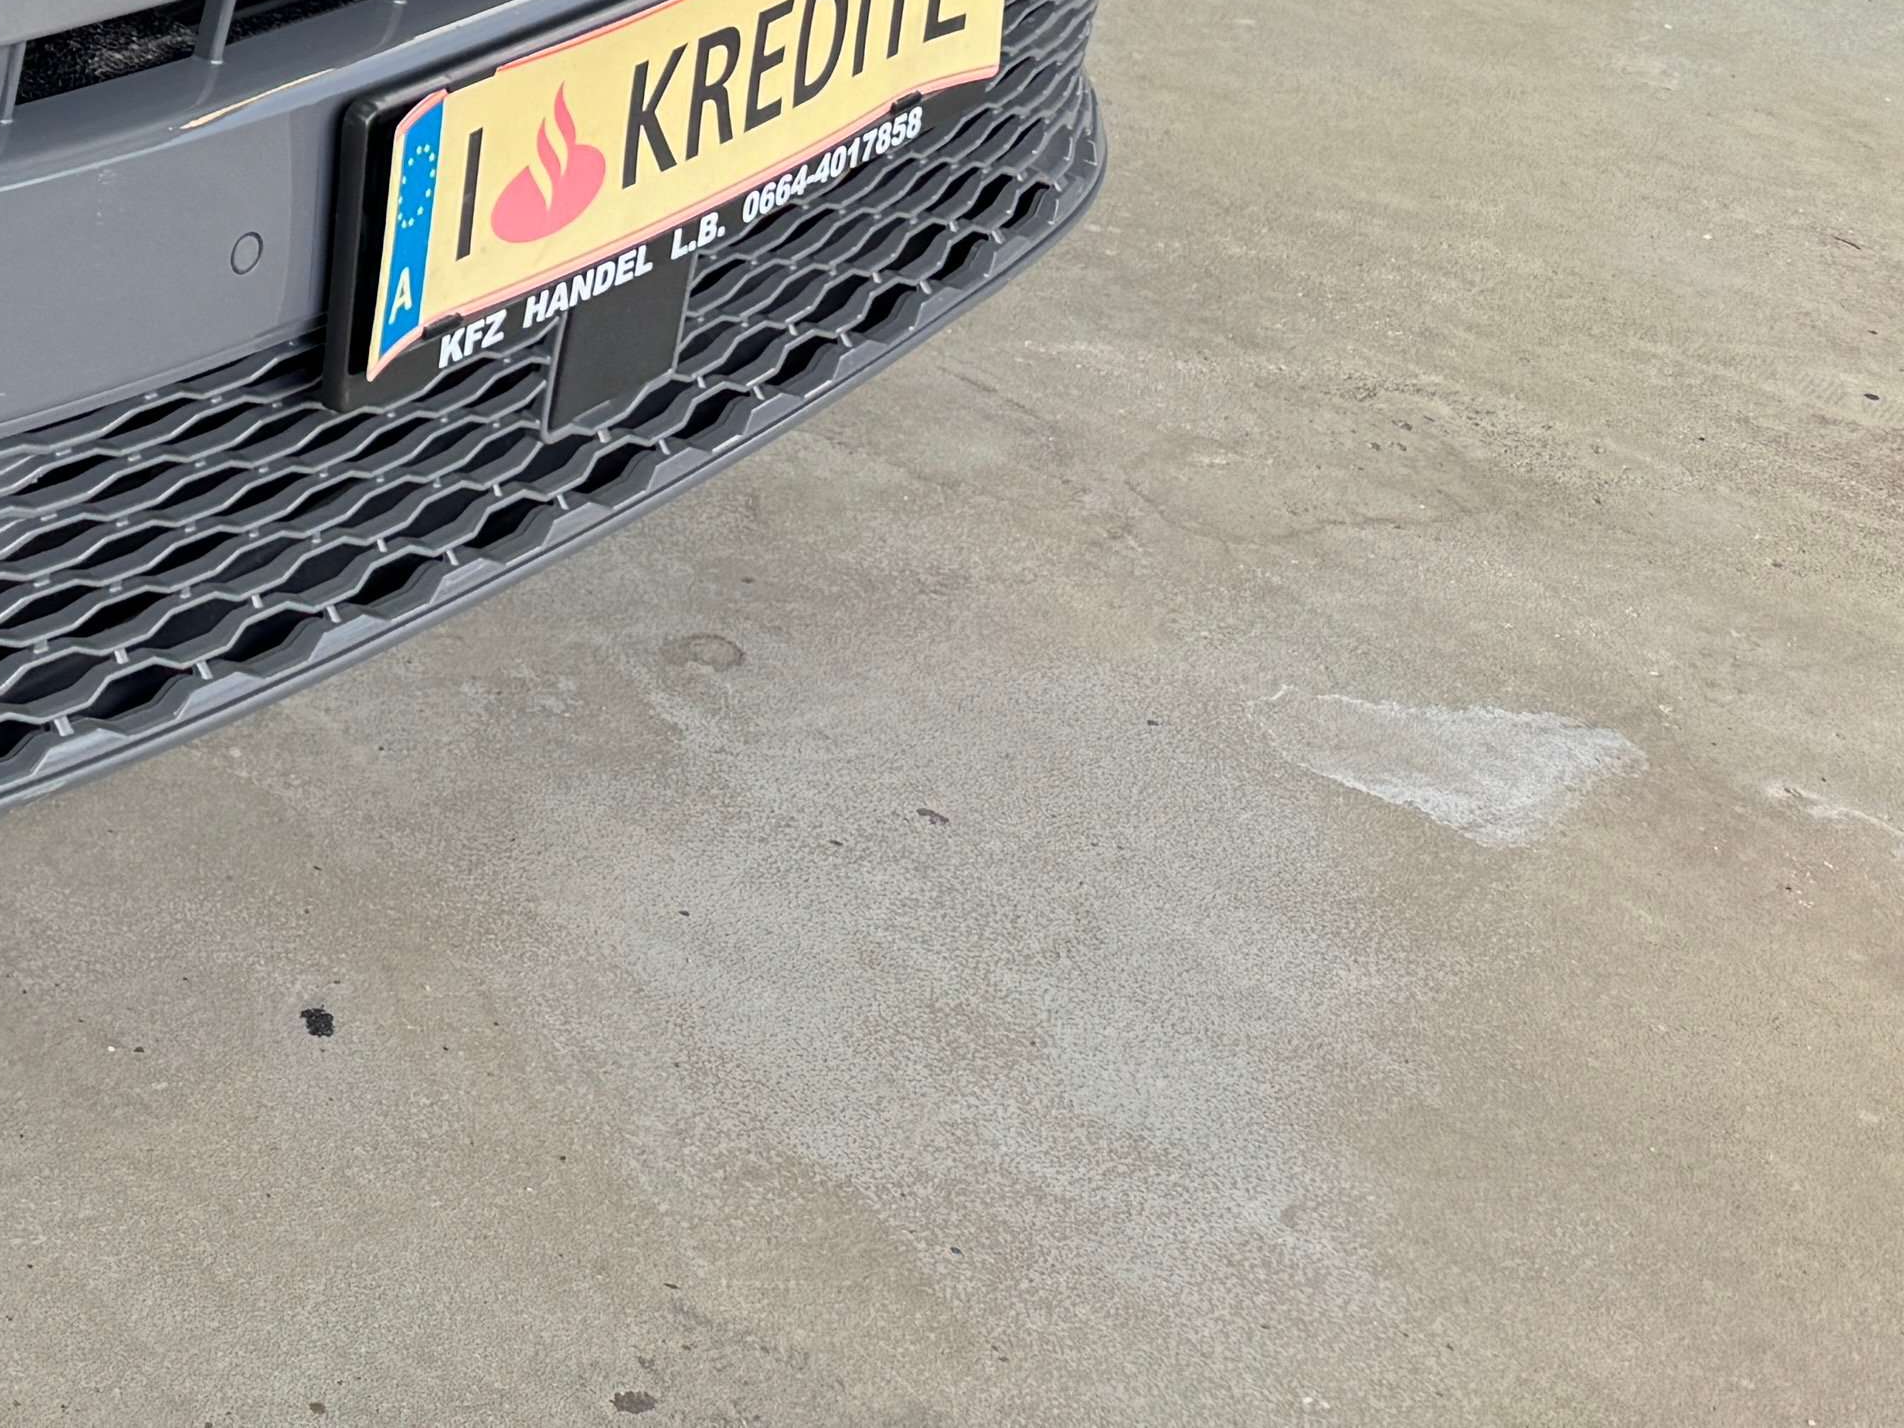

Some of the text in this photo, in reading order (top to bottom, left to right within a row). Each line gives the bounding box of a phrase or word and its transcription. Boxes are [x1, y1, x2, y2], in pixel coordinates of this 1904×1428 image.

[389, 266, 414, 325] A
[438, 104, 923, 368] KFZ HANDEL L.B. 0664-4017858
